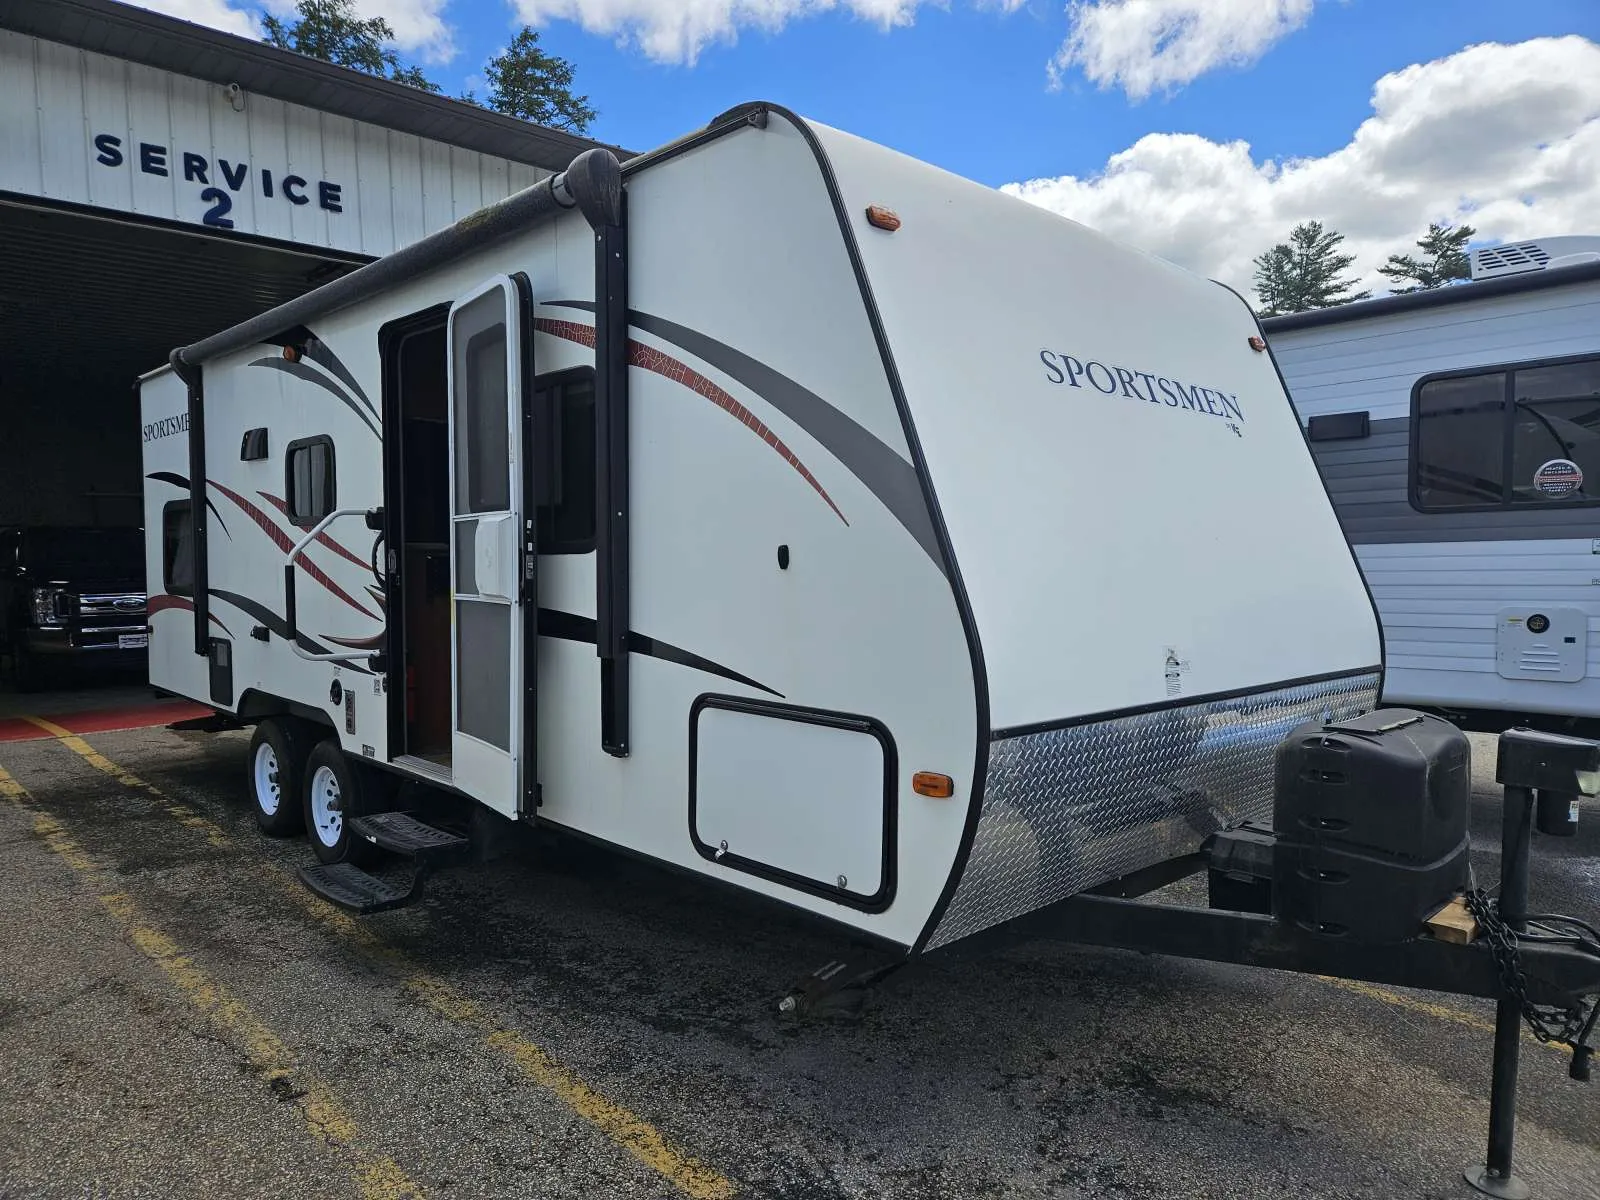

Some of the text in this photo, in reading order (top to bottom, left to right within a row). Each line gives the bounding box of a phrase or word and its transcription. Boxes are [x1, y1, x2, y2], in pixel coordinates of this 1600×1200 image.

[94, 134, 343, 213] SERVICE
[201, 187, 234, 229] 2
[1039, 349, 1245, 423] SPORTSMEN
[143, 412, 190, 443] SPORTSME
